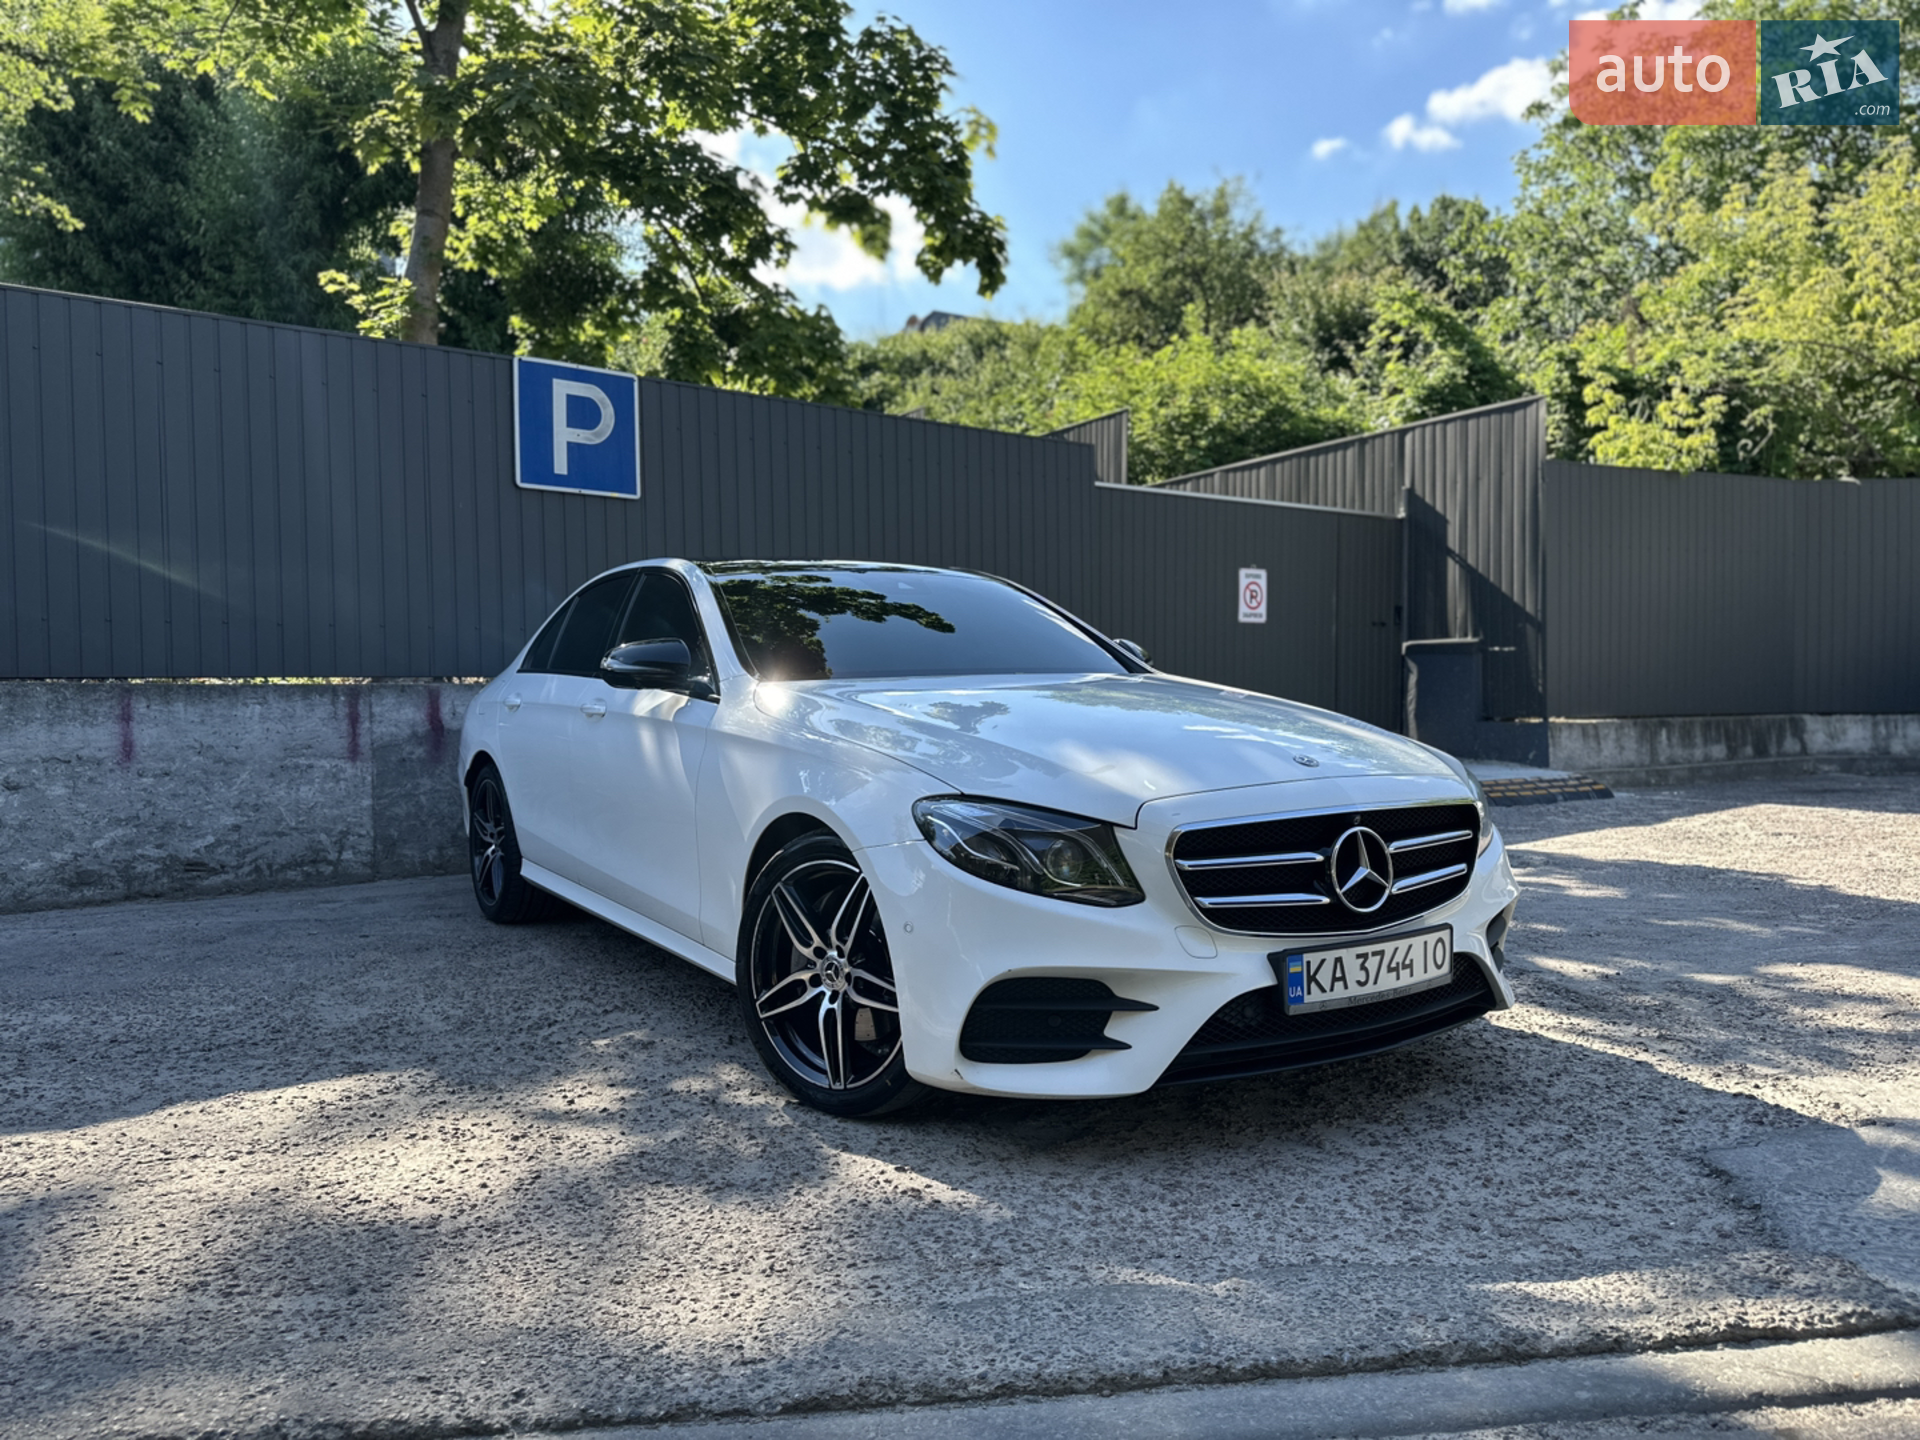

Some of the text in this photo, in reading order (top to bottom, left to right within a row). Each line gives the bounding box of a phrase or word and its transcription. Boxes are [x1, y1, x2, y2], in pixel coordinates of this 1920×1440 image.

[552, 378, 615, 475] P
[1288, 986, 1303, 998] UA
[1305, 937, 1446, 996] KA 3744 IO
